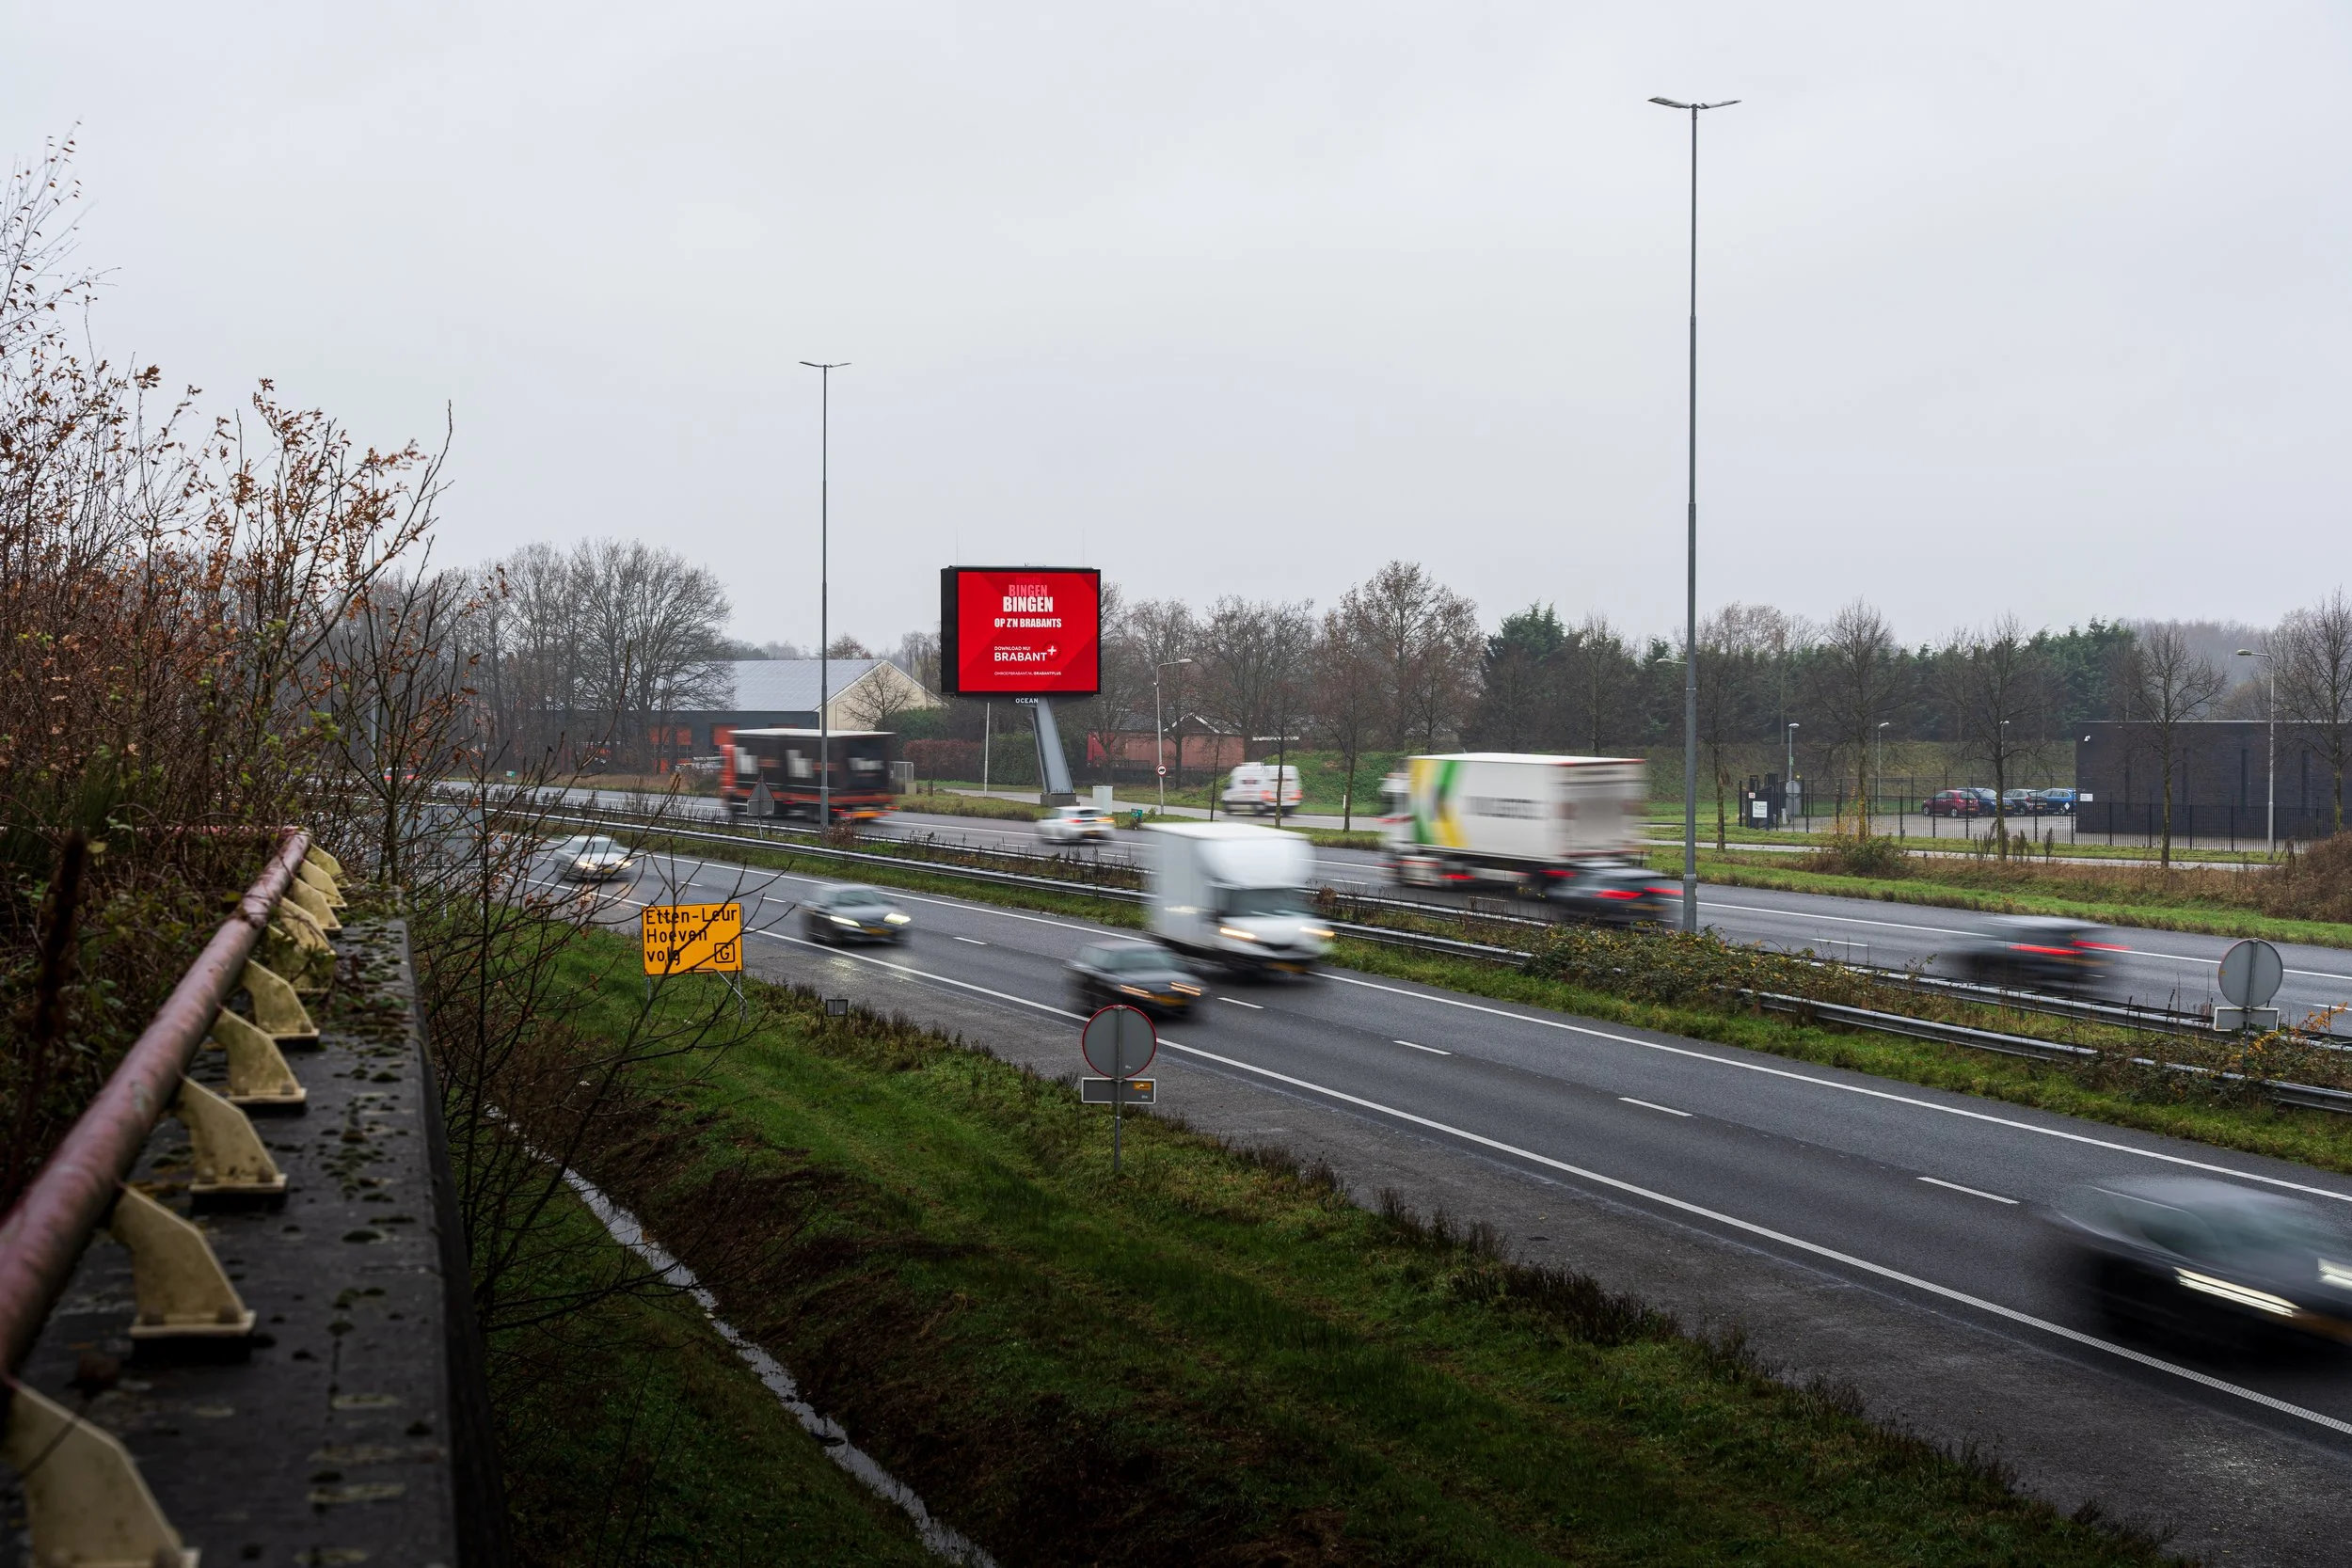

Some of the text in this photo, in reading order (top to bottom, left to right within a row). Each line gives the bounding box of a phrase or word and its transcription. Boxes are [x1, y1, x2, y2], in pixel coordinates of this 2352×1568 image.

[1009, 585, 1047, 596] BINGEN
[1003, 596, 1053, 612] BINGEN
[994, 618, 1062, 628] OP Z'N BRABANTS
[646, 908, 738, 925] Etten-Leur
[646, 927, 707, 943] Hoeven
[720, 945, 730, 960] G
